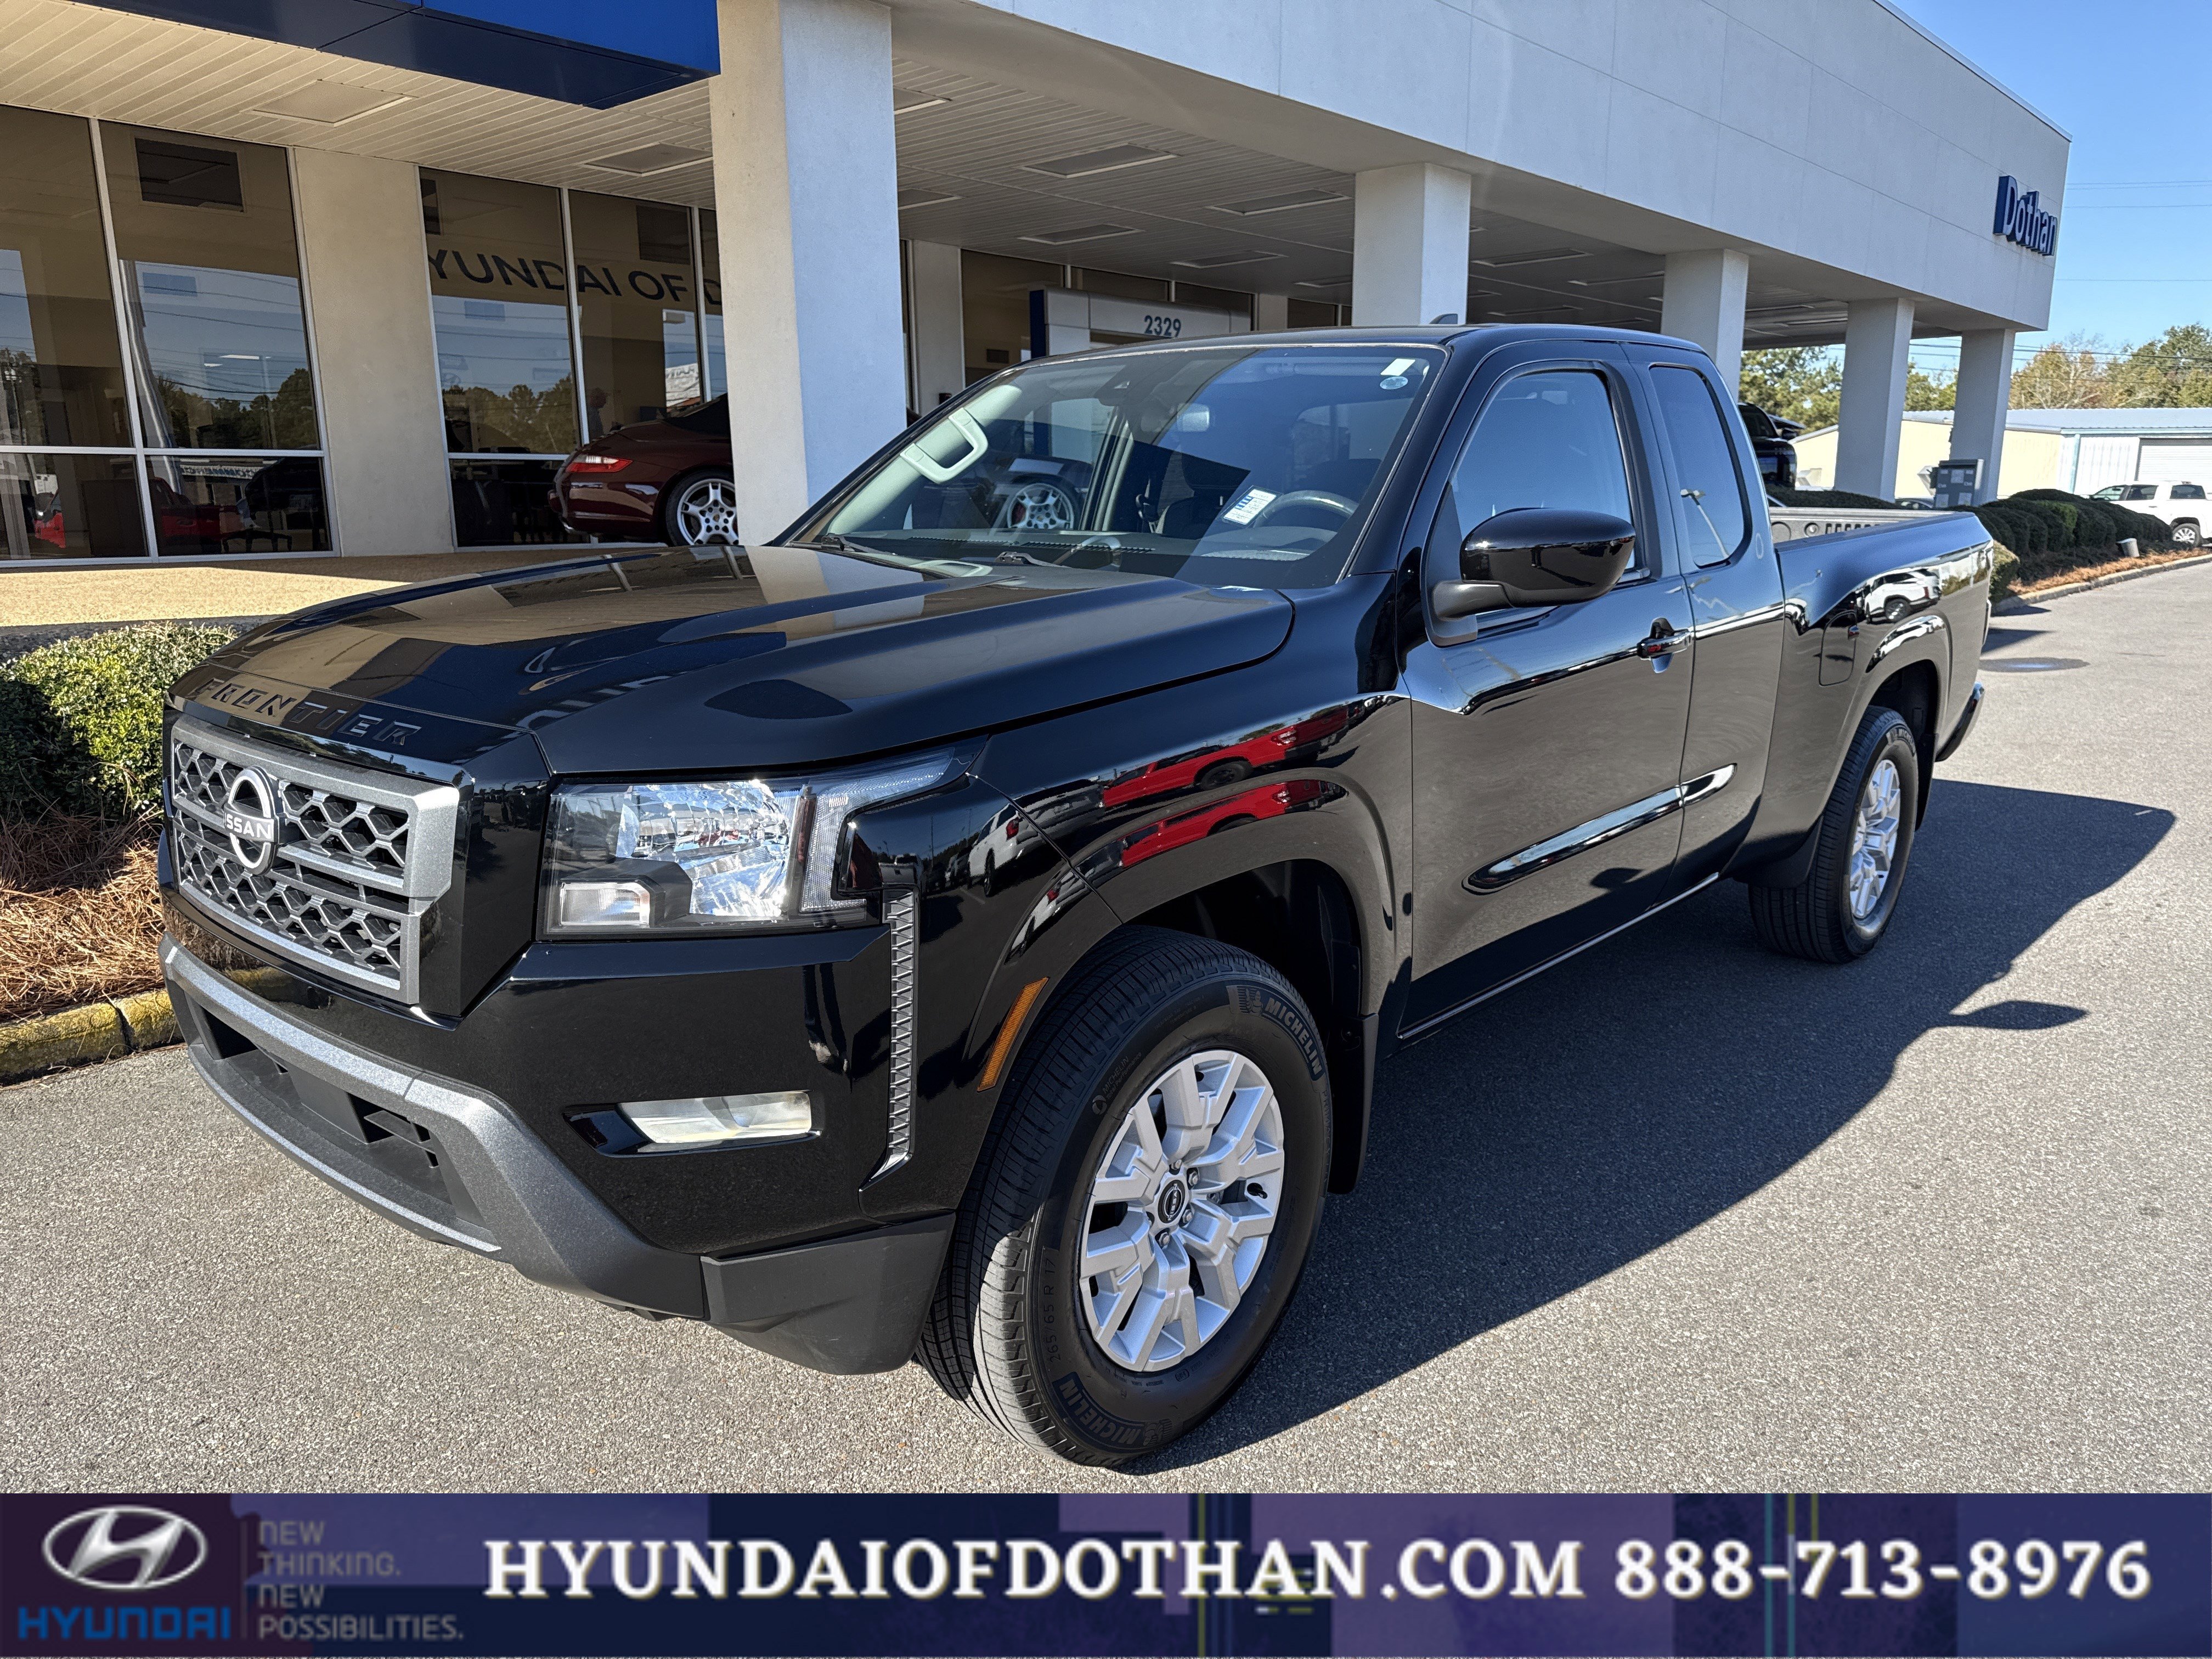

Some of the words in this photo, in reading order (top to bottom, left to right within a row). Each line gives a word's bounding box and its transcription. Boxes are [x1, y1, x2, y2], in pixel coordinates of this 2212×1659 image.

[1993, 175, 2058, 256] Dothan
[427, 249, 622, 297] YUNDAI
[628, 270, 689, 302] OF
[1144, 315, 1181, 337] 2329
[187, 678, 422, 746] FRONTIER
[224, 812, 272, 839] ISSAN
[1265, 997, 1322, 1075] MICHELIN
[1102, 1056, 1129, 1094] MICHELIN
[1167, 1183, 1178, 1221] NISSAN
[1045, 1258, 1056, 1275] 17
[1043, 1304, 1062, 1363] 265/65
[1059, 1379, 1142, 1444] MICHELIN
